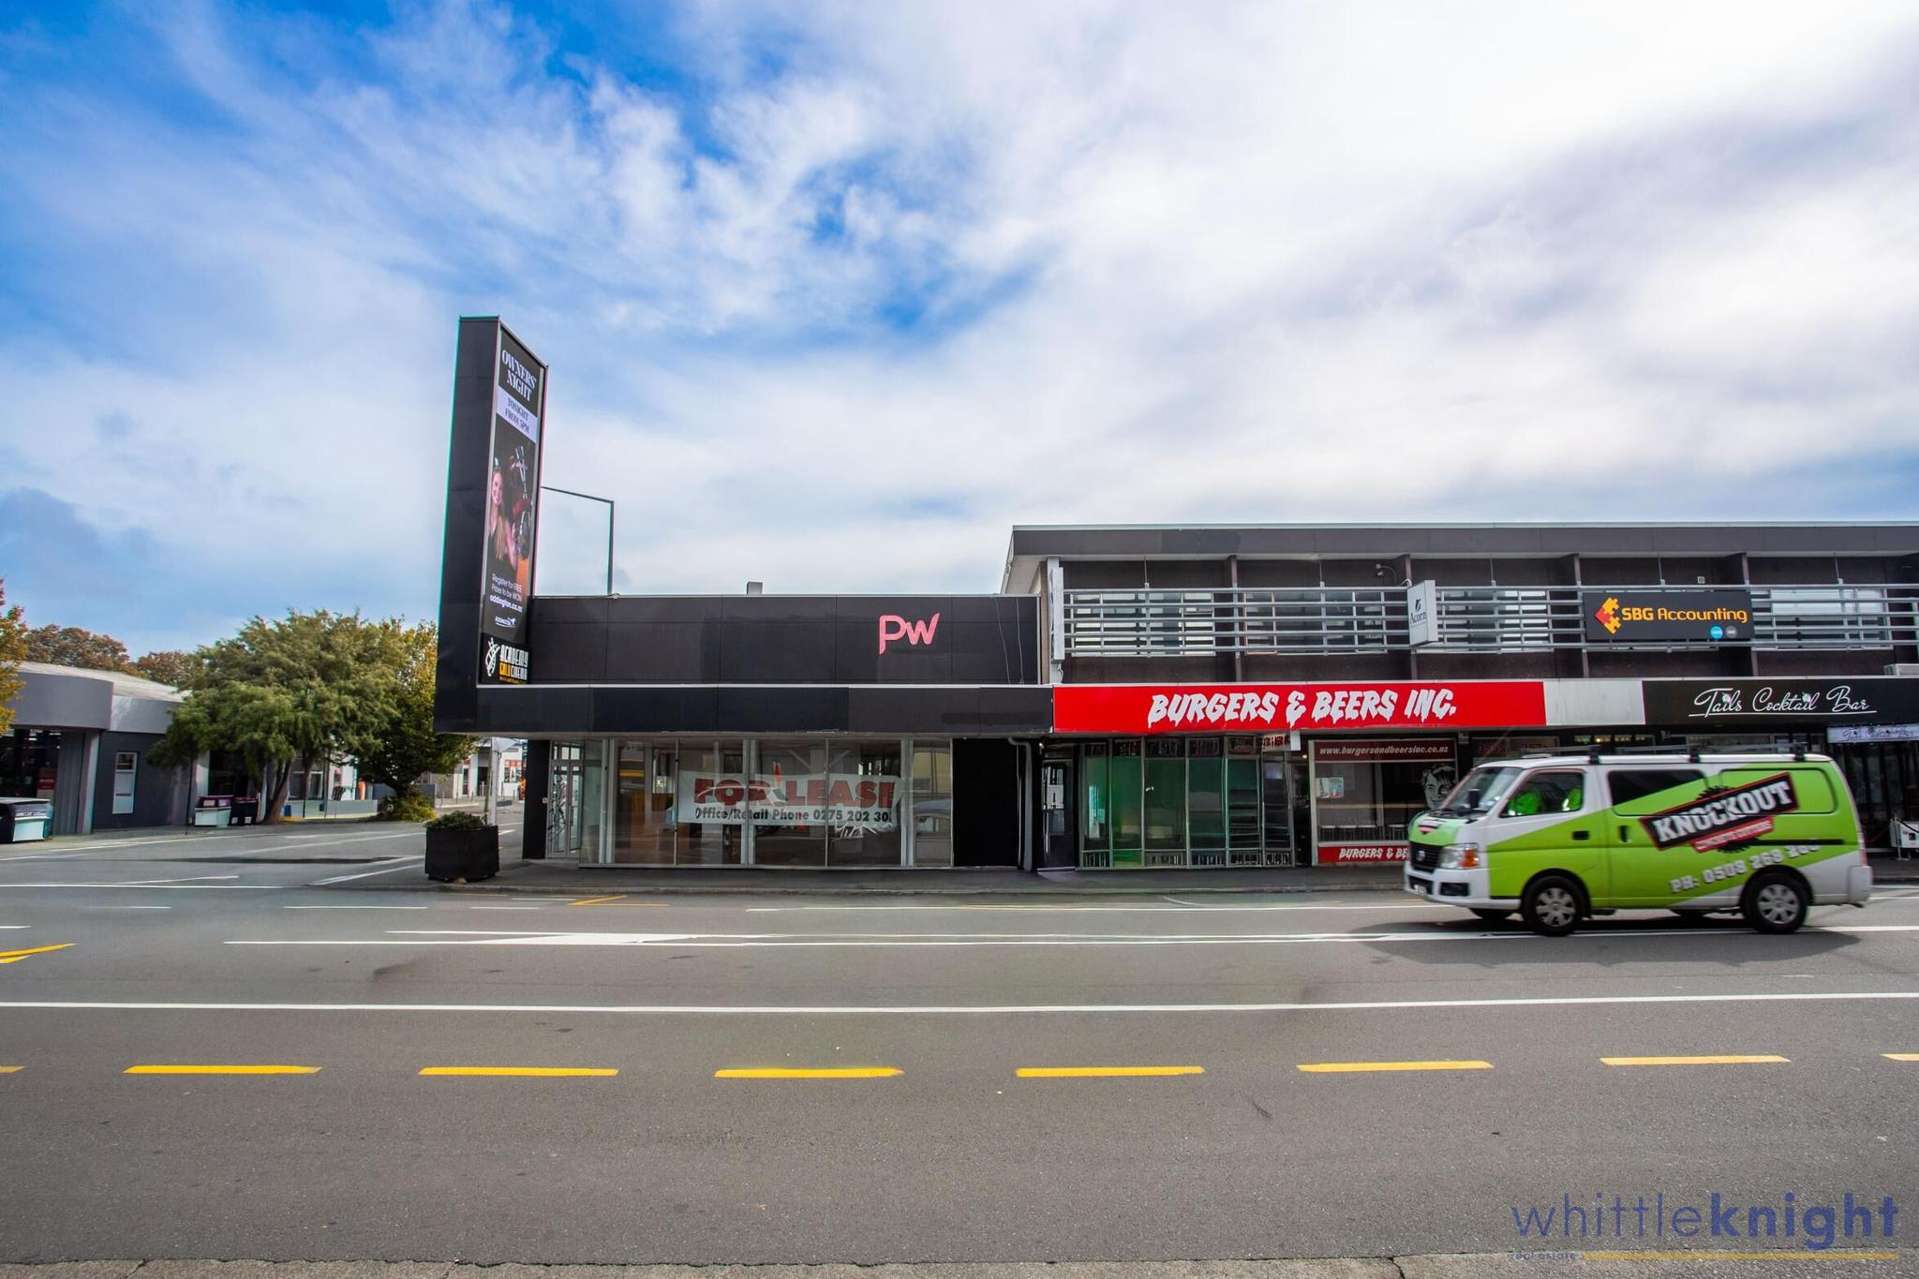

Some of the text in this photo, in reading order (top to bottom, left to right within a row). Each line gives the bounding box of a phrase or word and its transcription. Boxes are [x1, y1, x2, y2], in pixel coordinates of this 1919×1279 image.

[507, 369, 532, 401] NIGHT
[1621, 607, 1748, 624] SBG Accounting
[1147, 692, 1280, 728] BURGERS
[1286, 690, 1306, 729] &
[1311, 689, 1398, 725] BEERS
[1694, 685, 1870, 718] Tails Cocktail Bar
[772, 807, 809, 820] Phone
[874, 811, 893, 823] 30
[1653, 781, 1792, 842] KNOCKOUT
[1339, 847, 1383, 860] BURGERS
